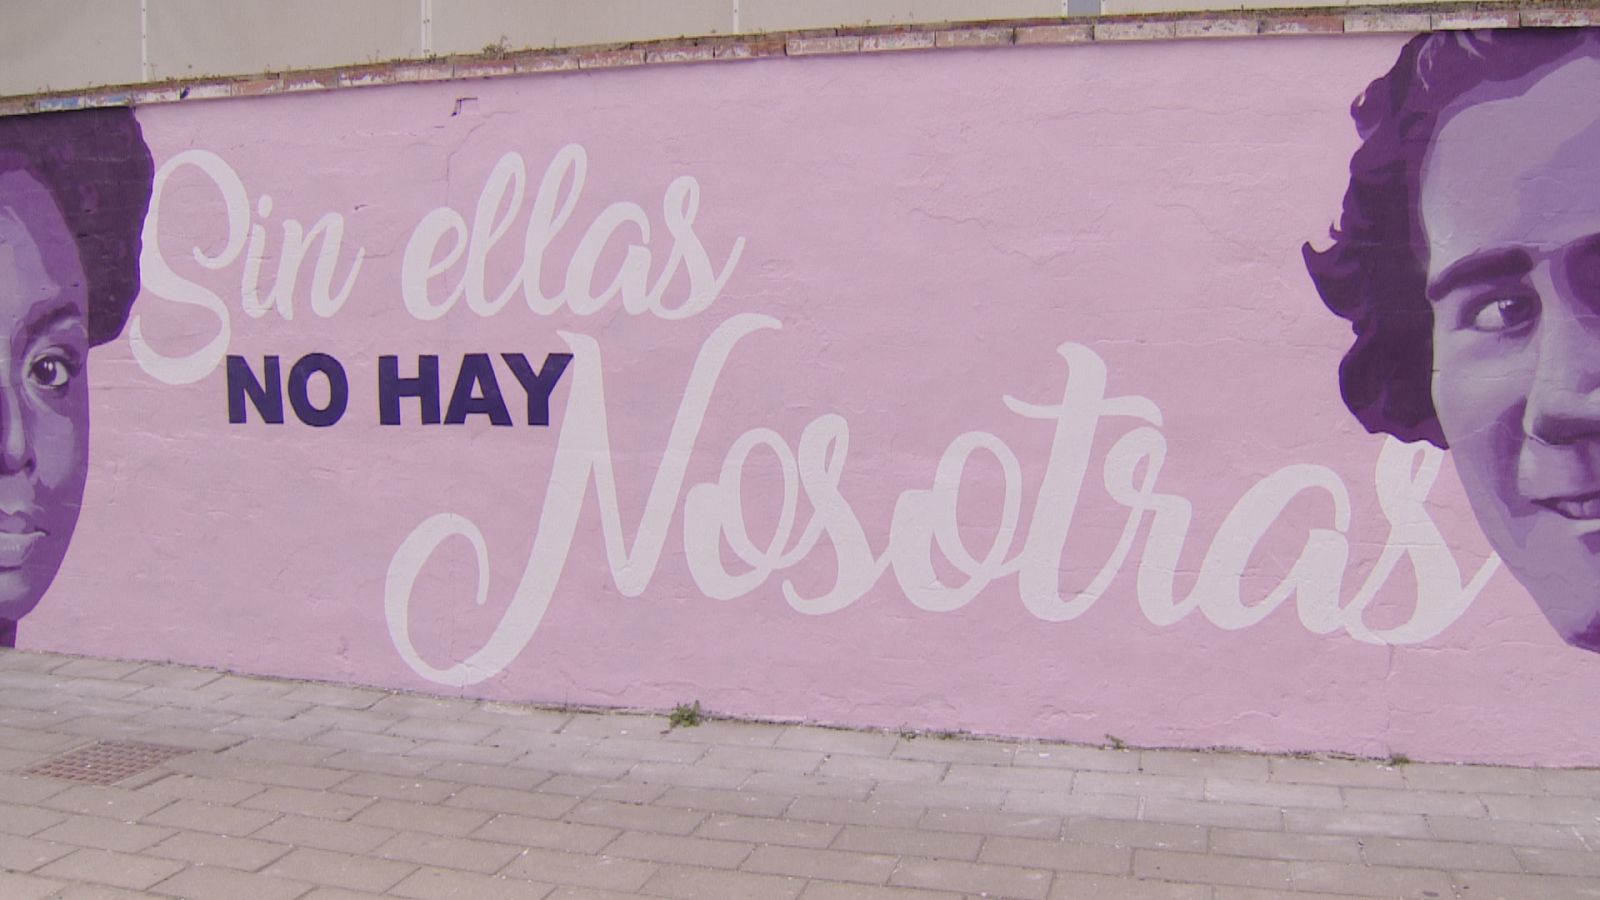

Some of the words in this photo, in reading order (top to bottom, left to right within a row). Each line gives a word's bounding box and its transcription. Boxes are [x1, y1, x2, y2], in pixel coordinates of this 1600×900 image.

[129, 149, 366, 385] Sin
[402, 144, 746, 320] ellas
[227, 353, 348, 426] NO
[379, 352, 573, 426] HAY
[385, 314, 1502, 686] Nosotras
